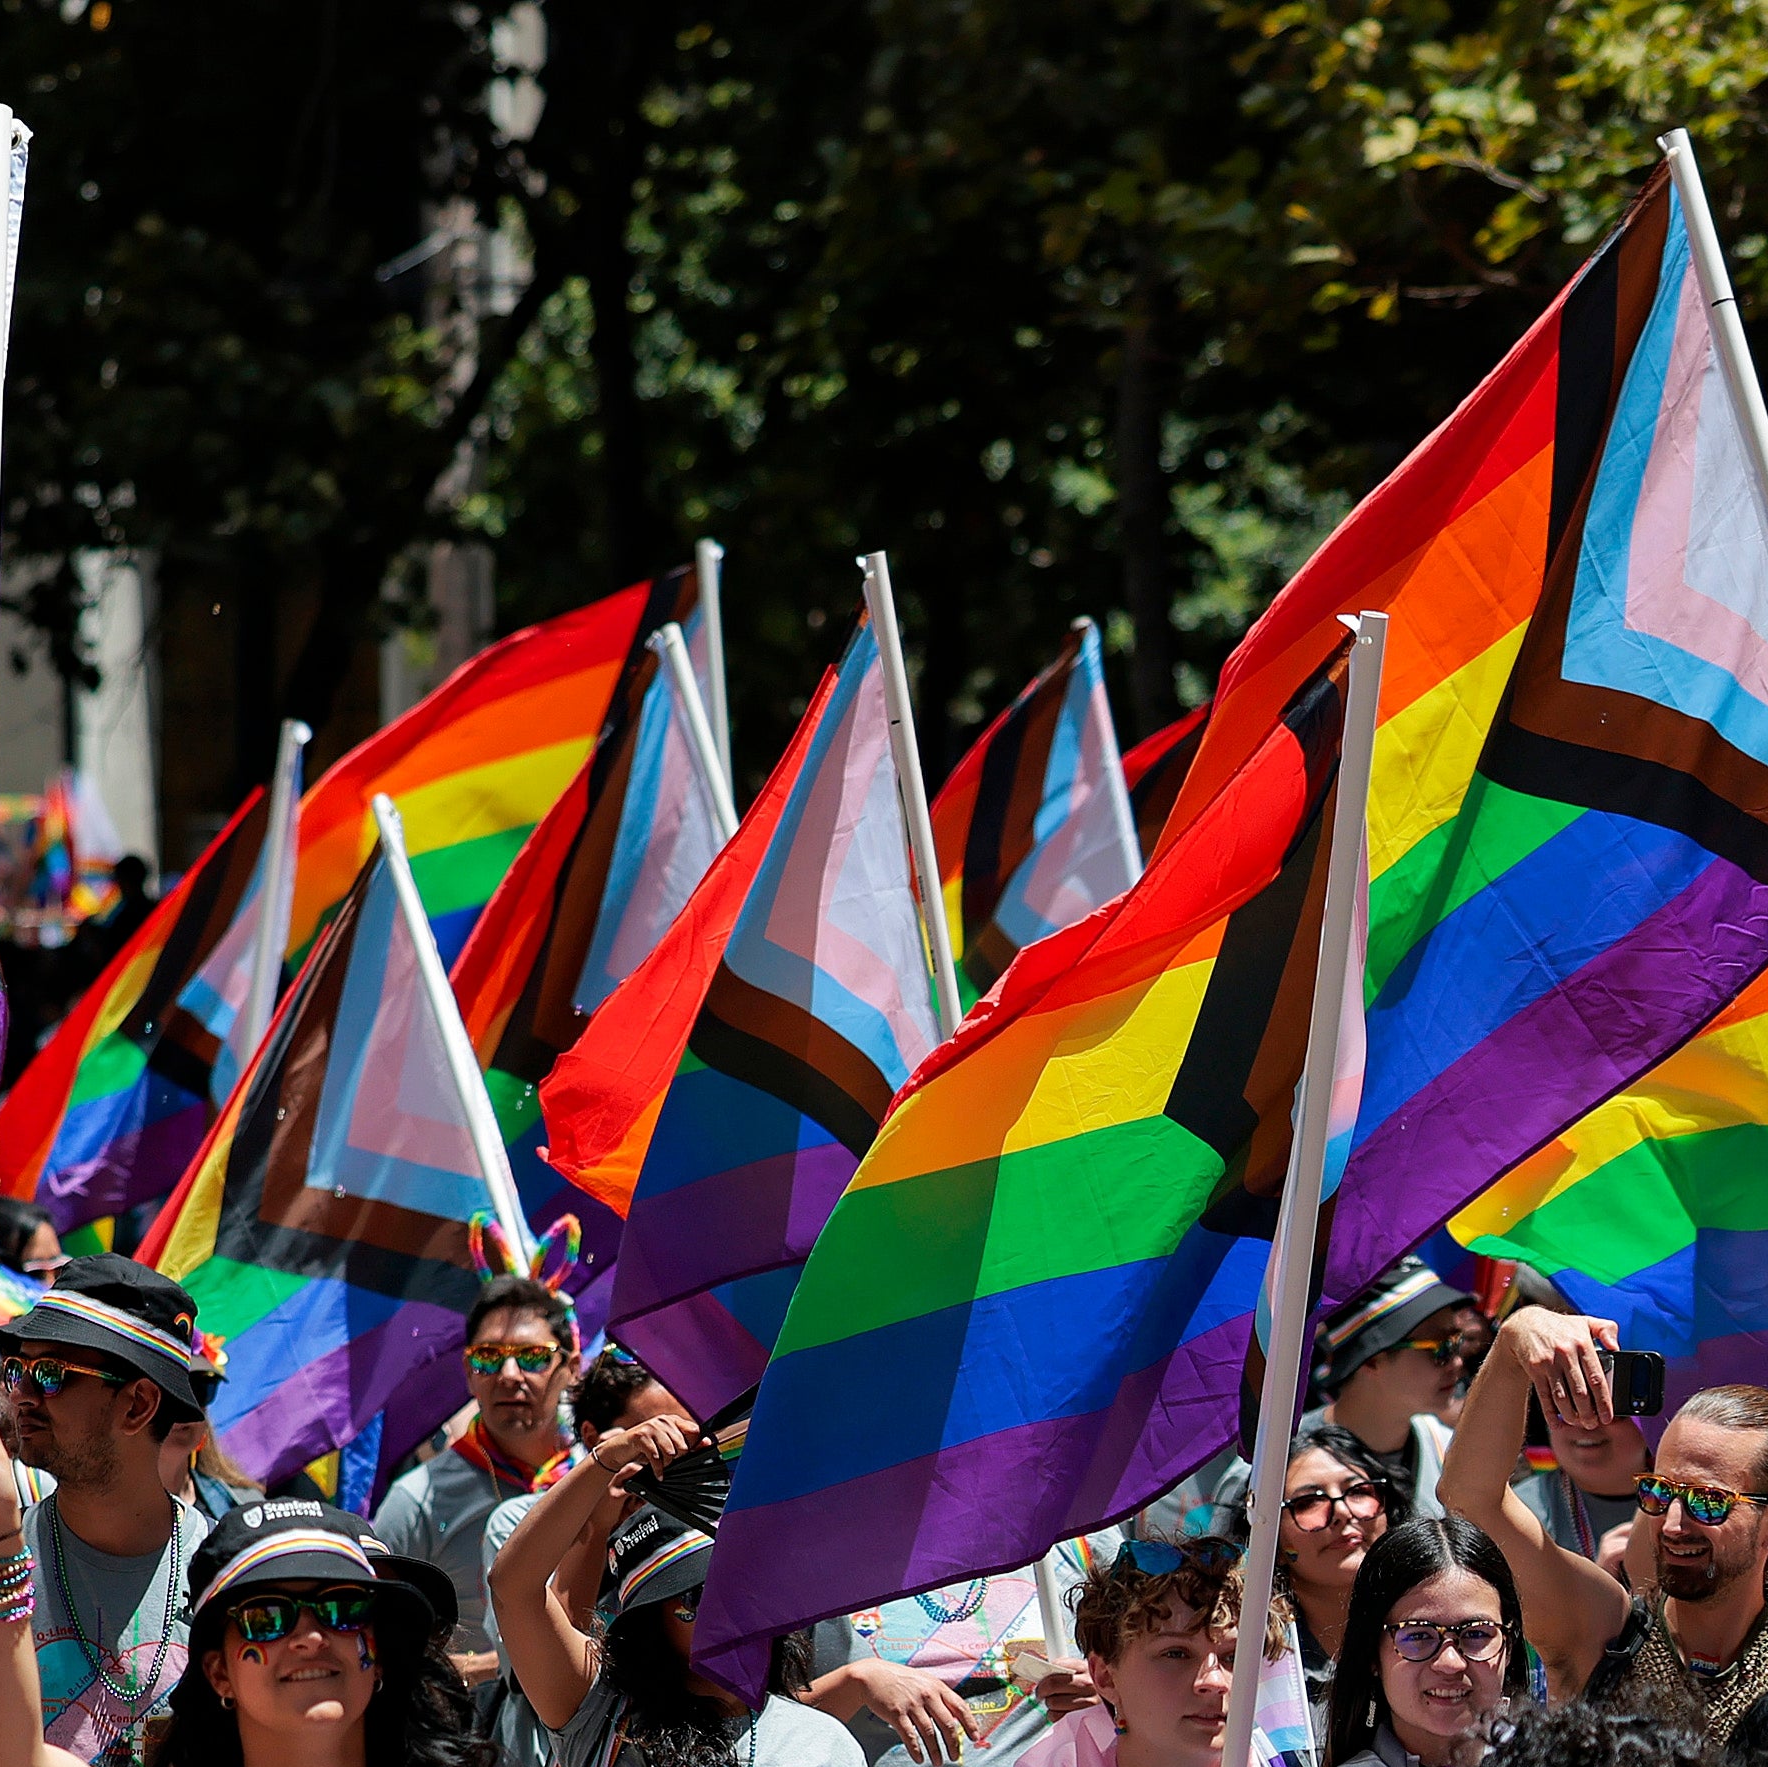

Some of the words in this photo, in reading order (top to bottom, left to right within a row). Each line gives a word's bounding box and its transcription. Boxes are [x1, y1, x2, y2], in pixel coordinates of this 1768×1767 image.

[263, 1500, 320, 1514] Stanford
[265, 1508, 324, 1520] MEDICINE
[622, 1515, 657, 1544] Stanford
[626, 1523, 659, 1550] MEDICINE
[36, 1626, 75, 1641] Q-Line
